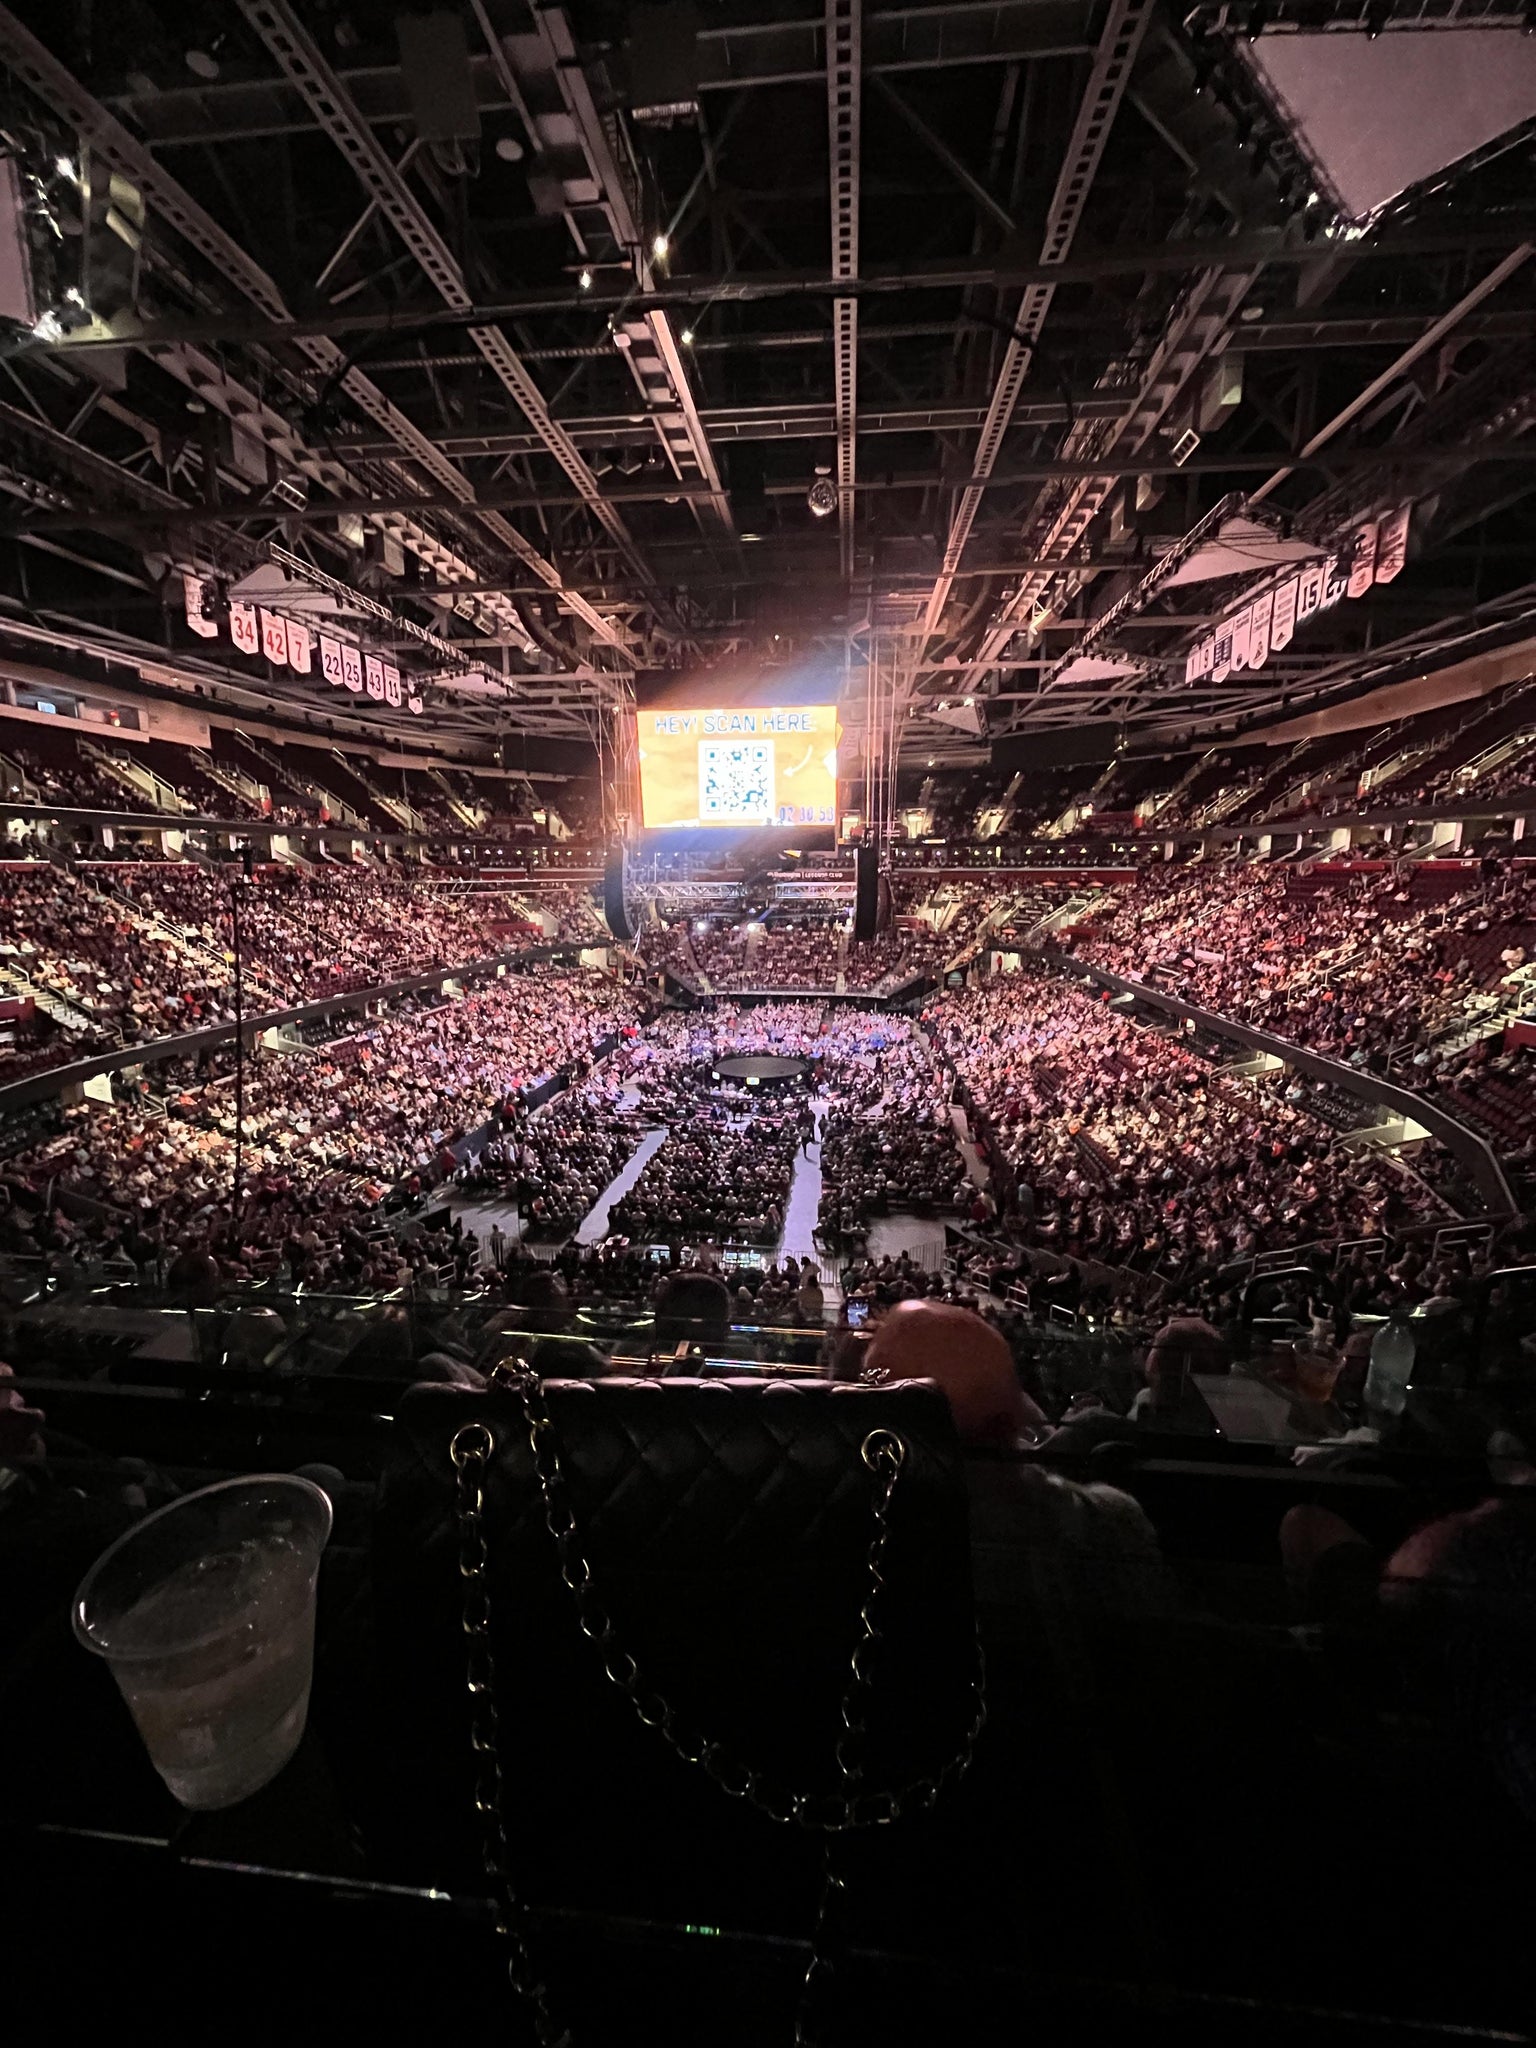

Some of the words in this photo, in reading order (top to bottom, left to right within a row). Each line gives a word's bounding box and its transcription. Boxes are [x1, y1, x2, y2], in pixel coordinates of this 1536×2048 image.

[1302, 580, 1319, 612] 15
[234, 615, 254, 644] 34
[266, 629, 284, 656] 42
[295, 640, 302, 661] 7
[324, 653, 340, 676] 22
[345, 661, 360, 683] 25
[369, 671, 381, 692] 43
[388, 680, 398, 699] 11
[704, 714, 756, 733] SCAN
[763, 713, 811, 732] HERE
